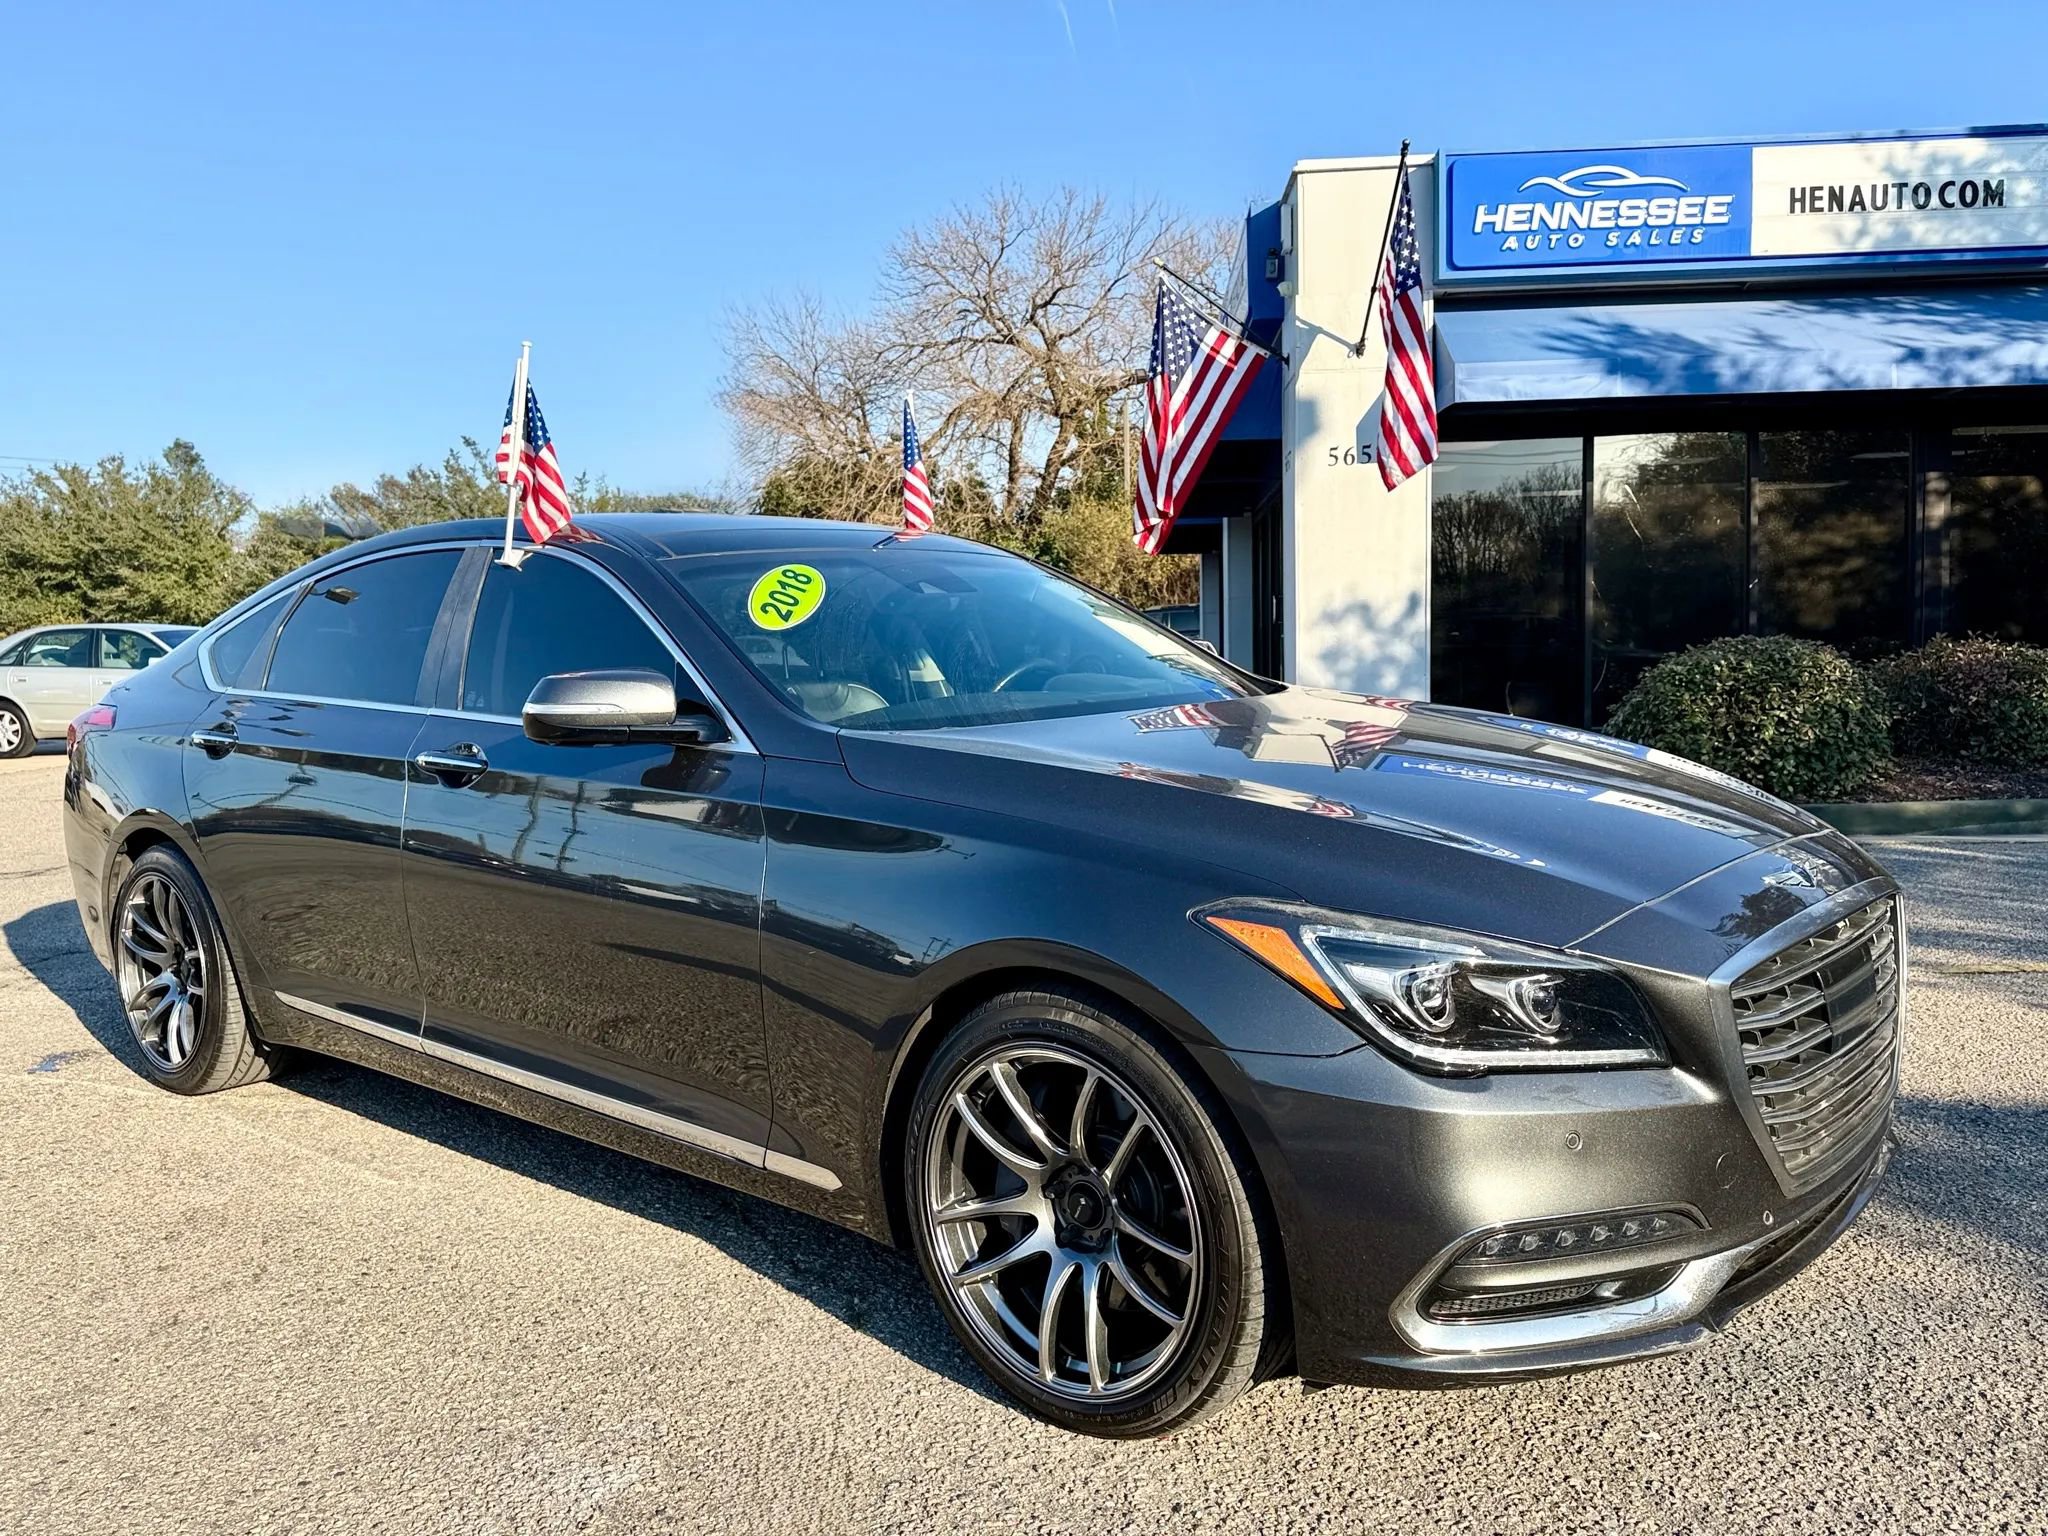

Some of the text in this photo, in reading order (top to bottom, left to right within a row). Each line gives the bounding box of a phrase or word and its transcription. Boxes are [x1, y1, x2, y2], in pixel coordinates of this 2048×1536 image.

[1474, 194, 1735, 233] HENNESSEE
[1501, 227, 1706, 251] AUTO SALES
[760, 569, 812, 622] 2018
